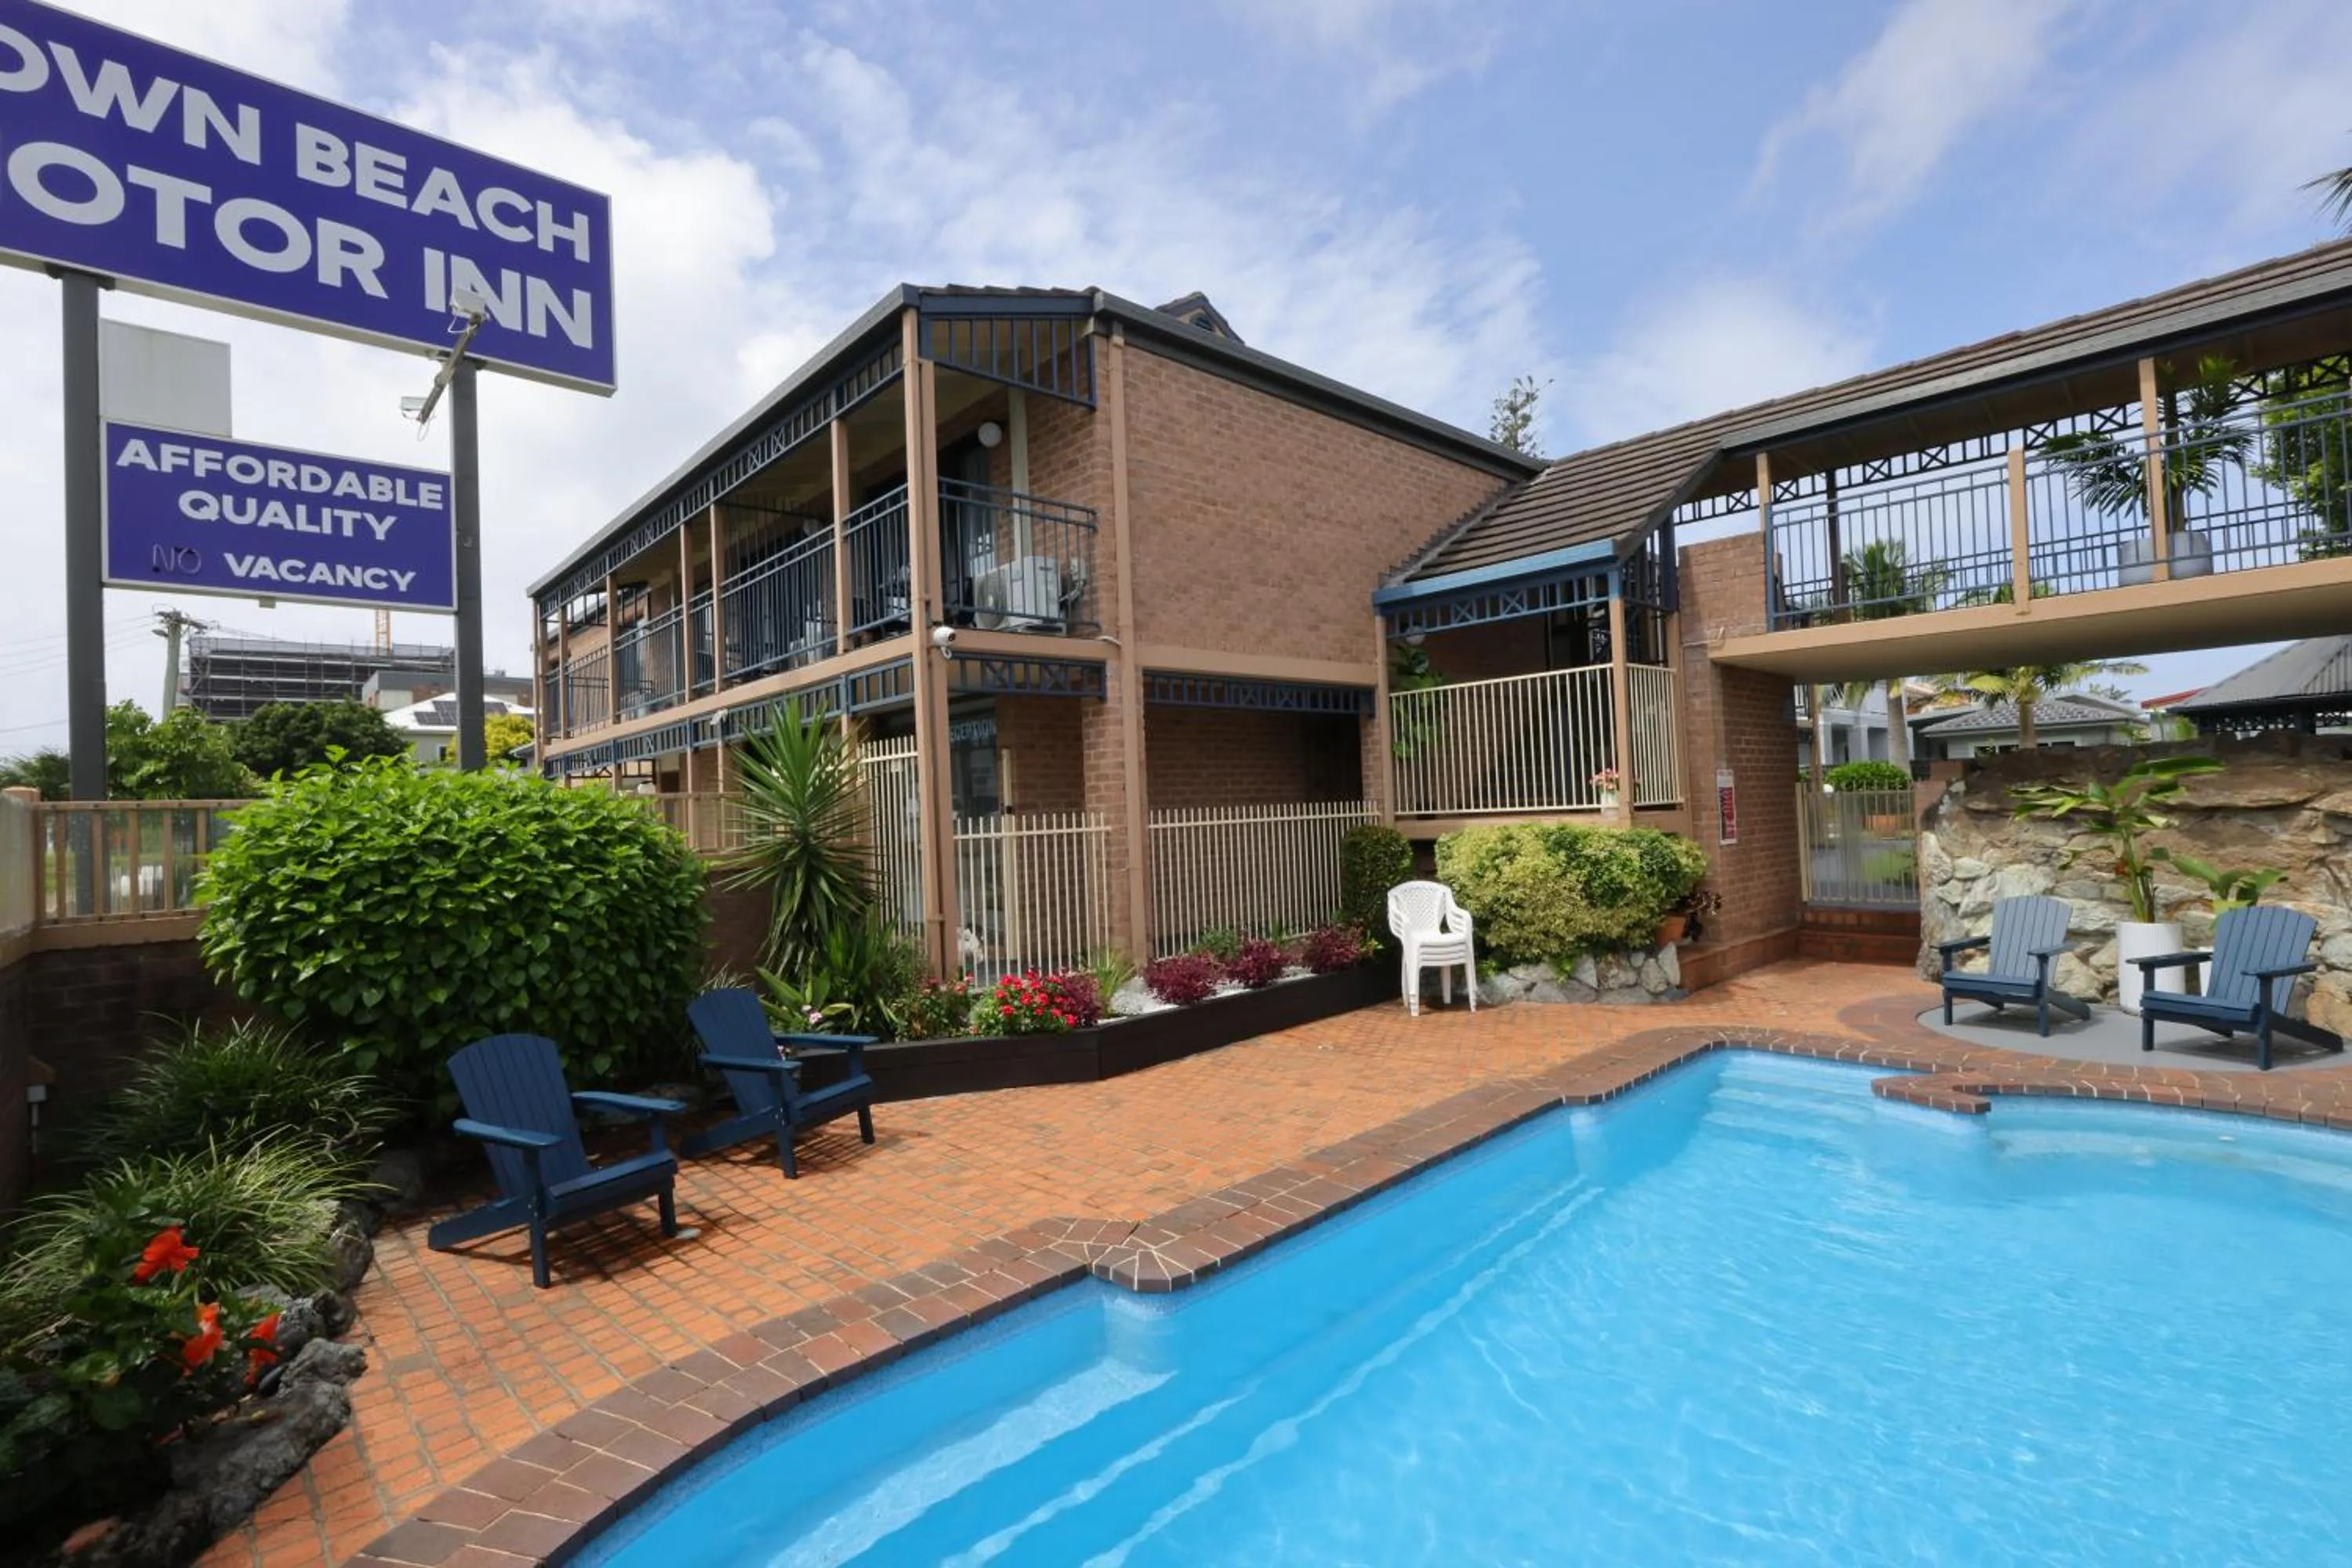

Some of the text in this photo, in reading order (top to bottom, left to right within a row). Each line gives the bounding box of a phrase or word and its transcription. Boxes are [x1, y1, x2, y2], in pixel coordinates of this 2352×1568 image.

[296, 122, 590, 263] BEACH
[423, 247, 593, 350] INN
[116, 439, 443, 510] AFFORDABLE
[178, 490, 397, 540] QUALITY
[152, 544, 416, 592] NO VACANCY
